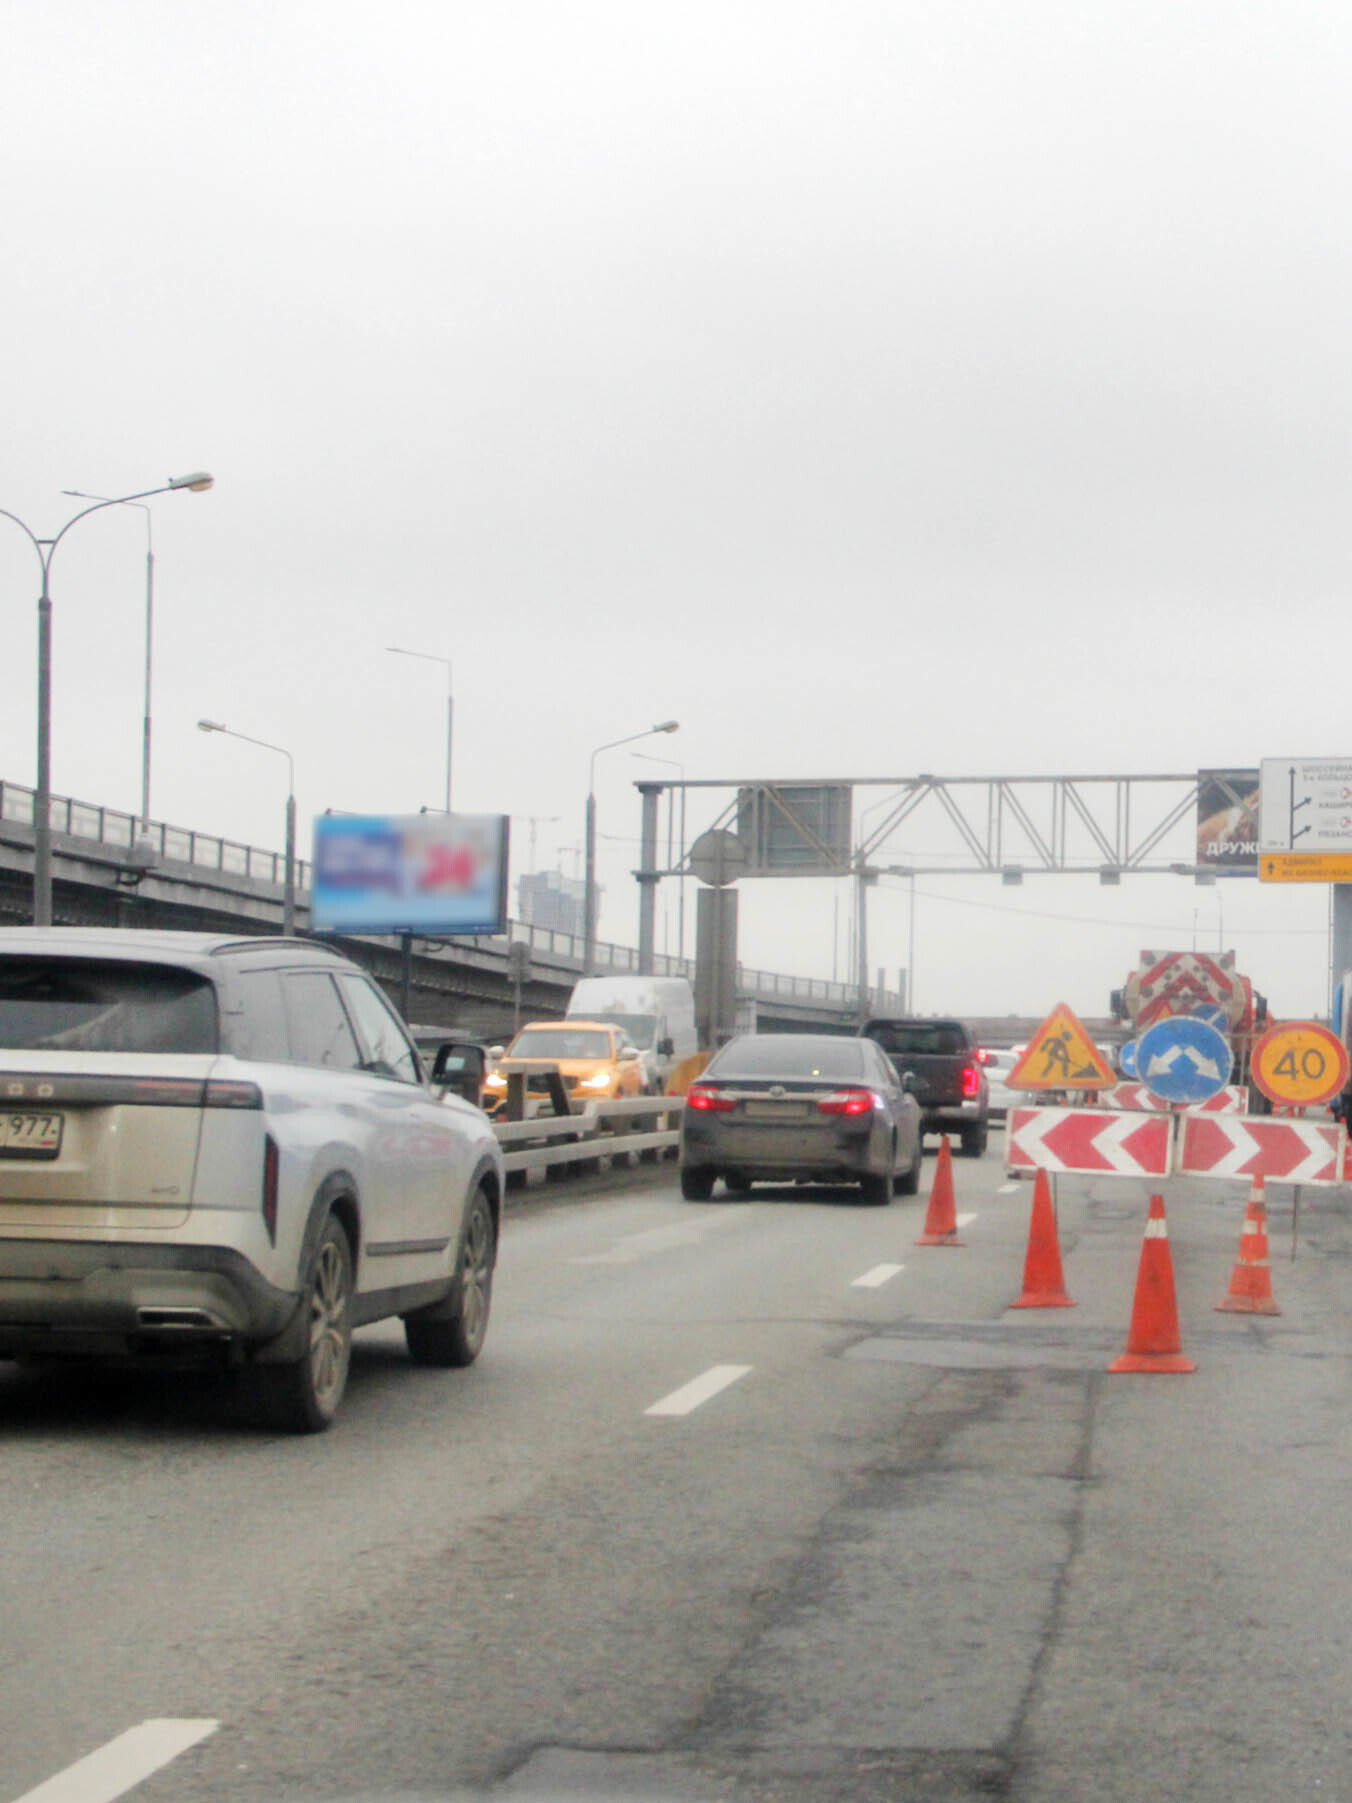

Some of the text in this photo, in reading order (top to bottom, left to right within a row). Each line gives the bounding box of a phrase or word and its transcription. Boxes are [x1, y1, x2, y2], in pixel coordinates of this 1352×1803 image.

[1206, 841, 1261, 857] ДРУЖ
[1272, 1049, 1326, 1080] 40
[10, 1115, 52, 1136] 977
